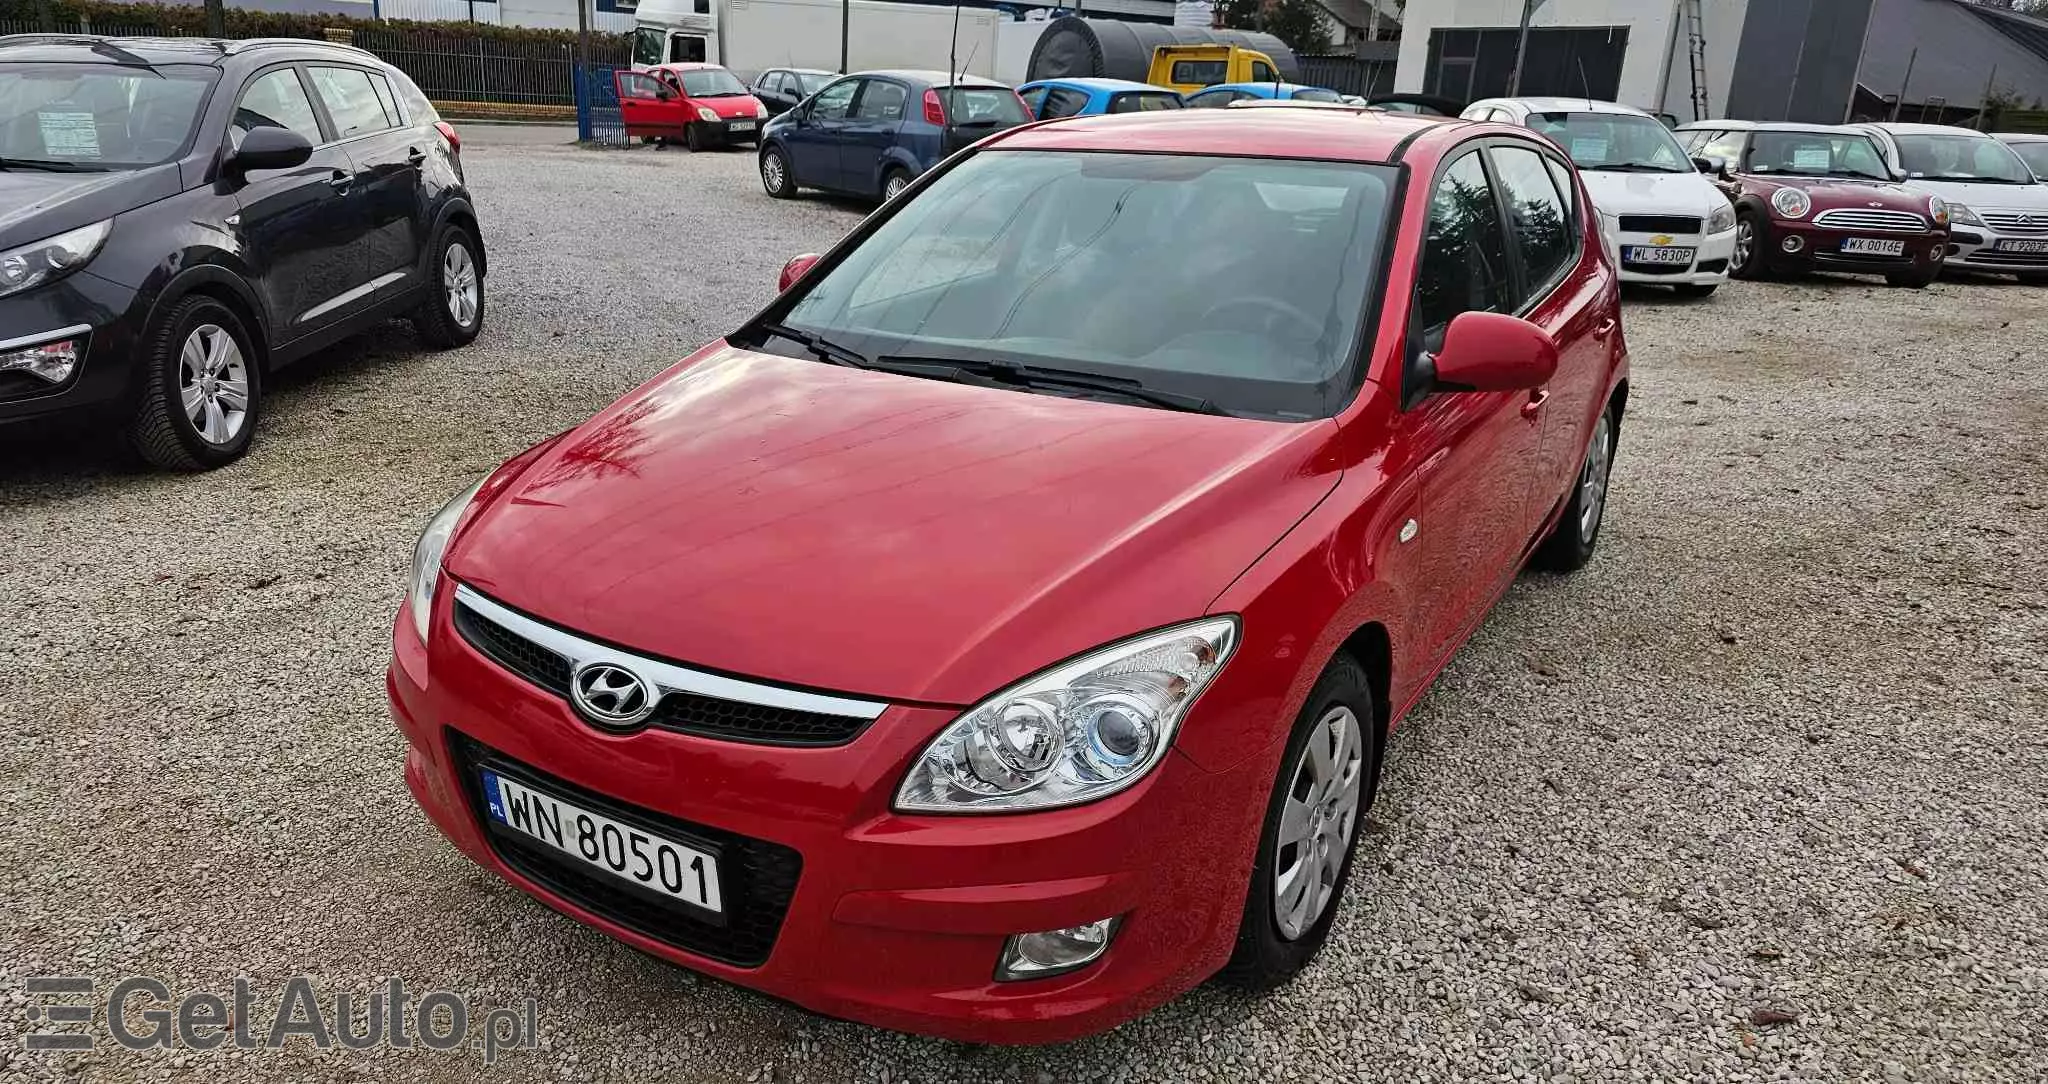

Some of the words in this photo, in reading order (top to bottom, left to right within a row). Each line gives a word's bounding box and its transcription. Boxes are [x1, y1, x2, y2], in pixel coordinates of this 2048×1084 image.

[1849, 239, 1864, 250] WX
[1867, 240, 1901, 253] 0016E
[1633, 247, 1648, 260] WL
[1653, 248, 1692, 262] 5830P
[489, 801, 505, 818] PL
[503, 782, 565, 849] WN
[576, 813, 709, 905] 80501
